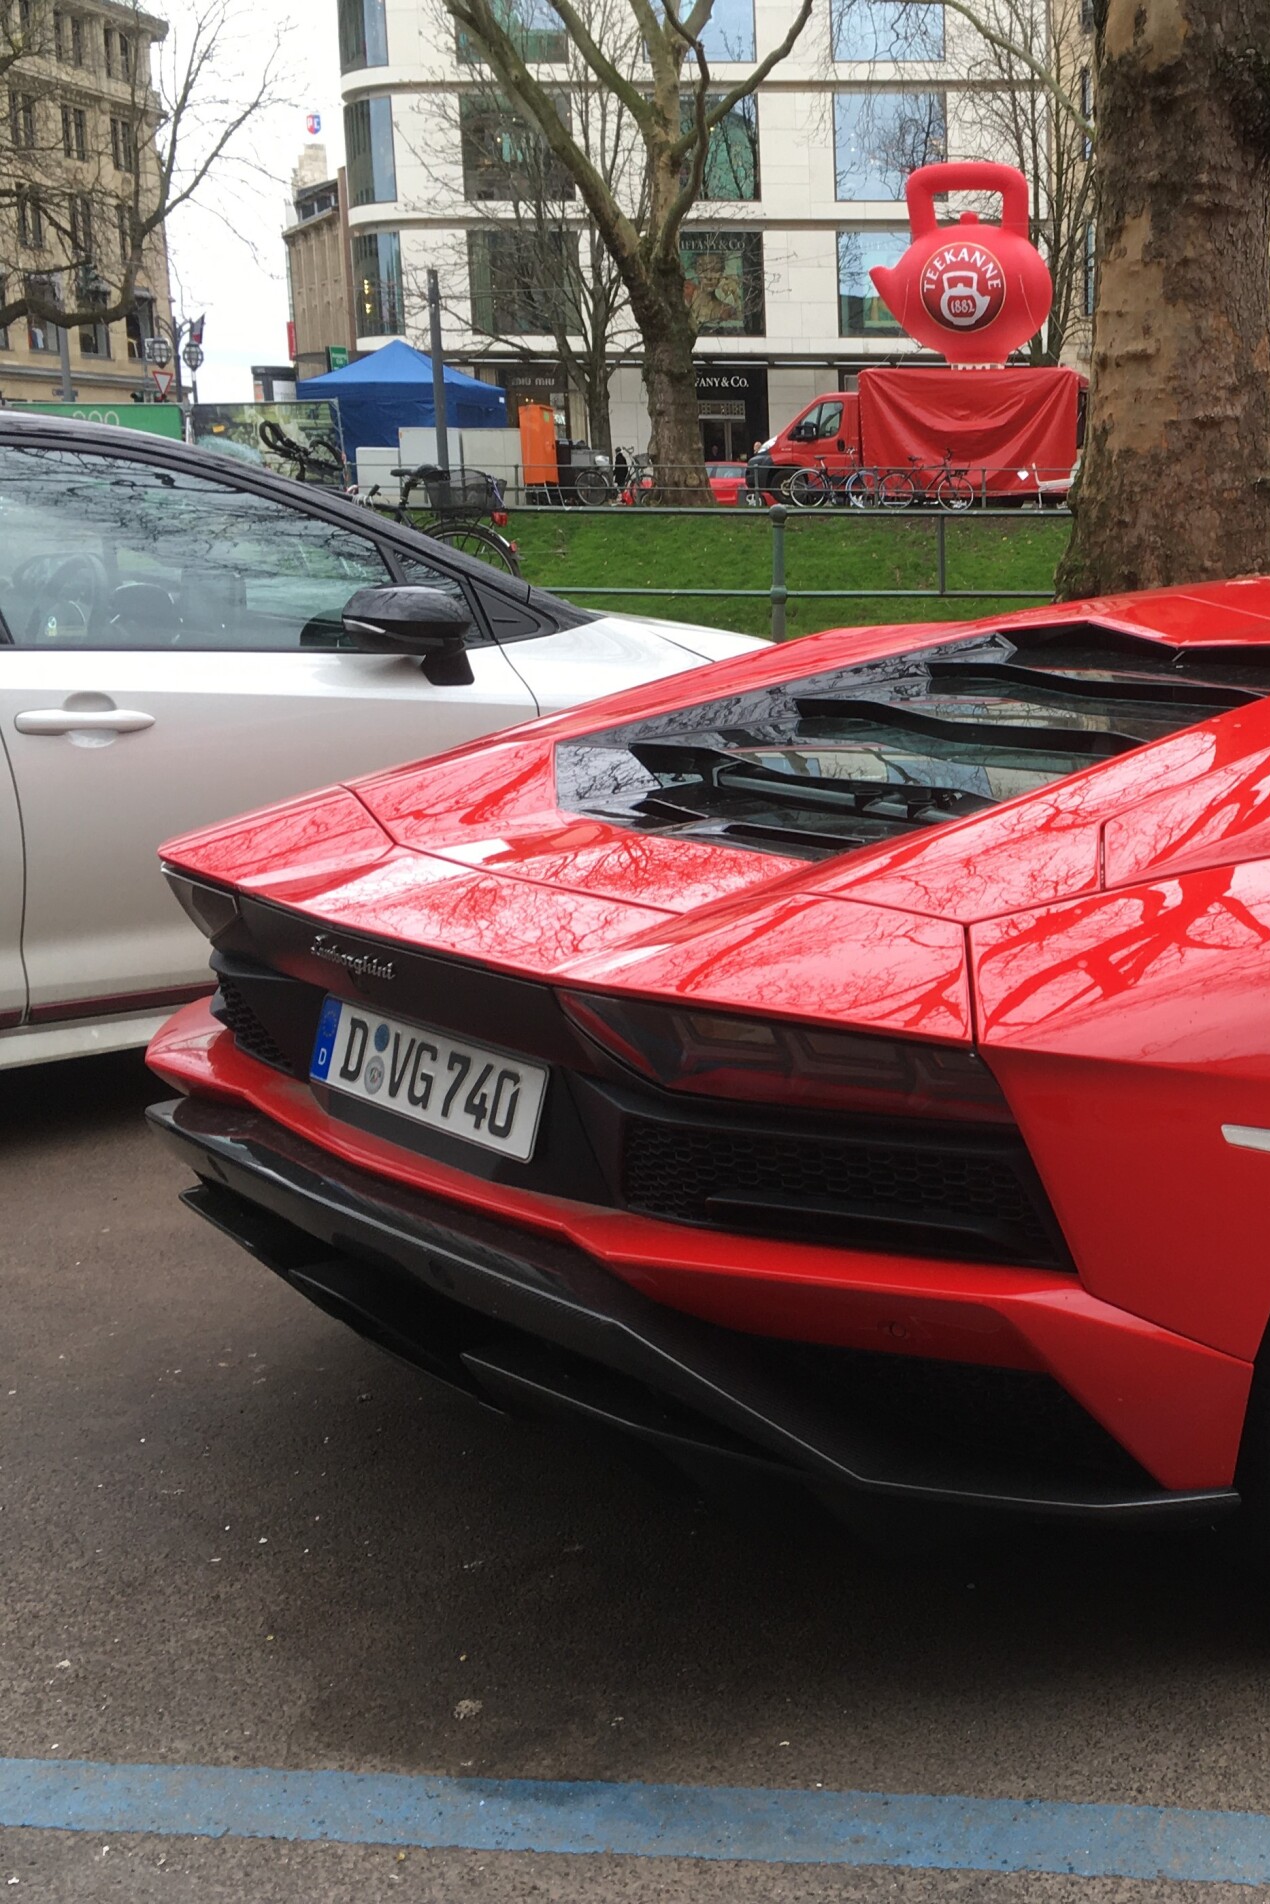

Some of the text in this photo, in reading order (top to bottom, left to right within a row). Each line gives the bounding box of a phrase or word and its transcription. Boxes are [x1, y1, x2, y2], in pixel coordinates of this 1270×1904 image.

[678, 239, 717, 250] IFFANY
[924, 247, 1002, 294] TEEKANNE
[950, 299, 975, 313] 1882
[311, 934, 396, 980] Lamborghini
[317, 1048, 328, 1066] D
